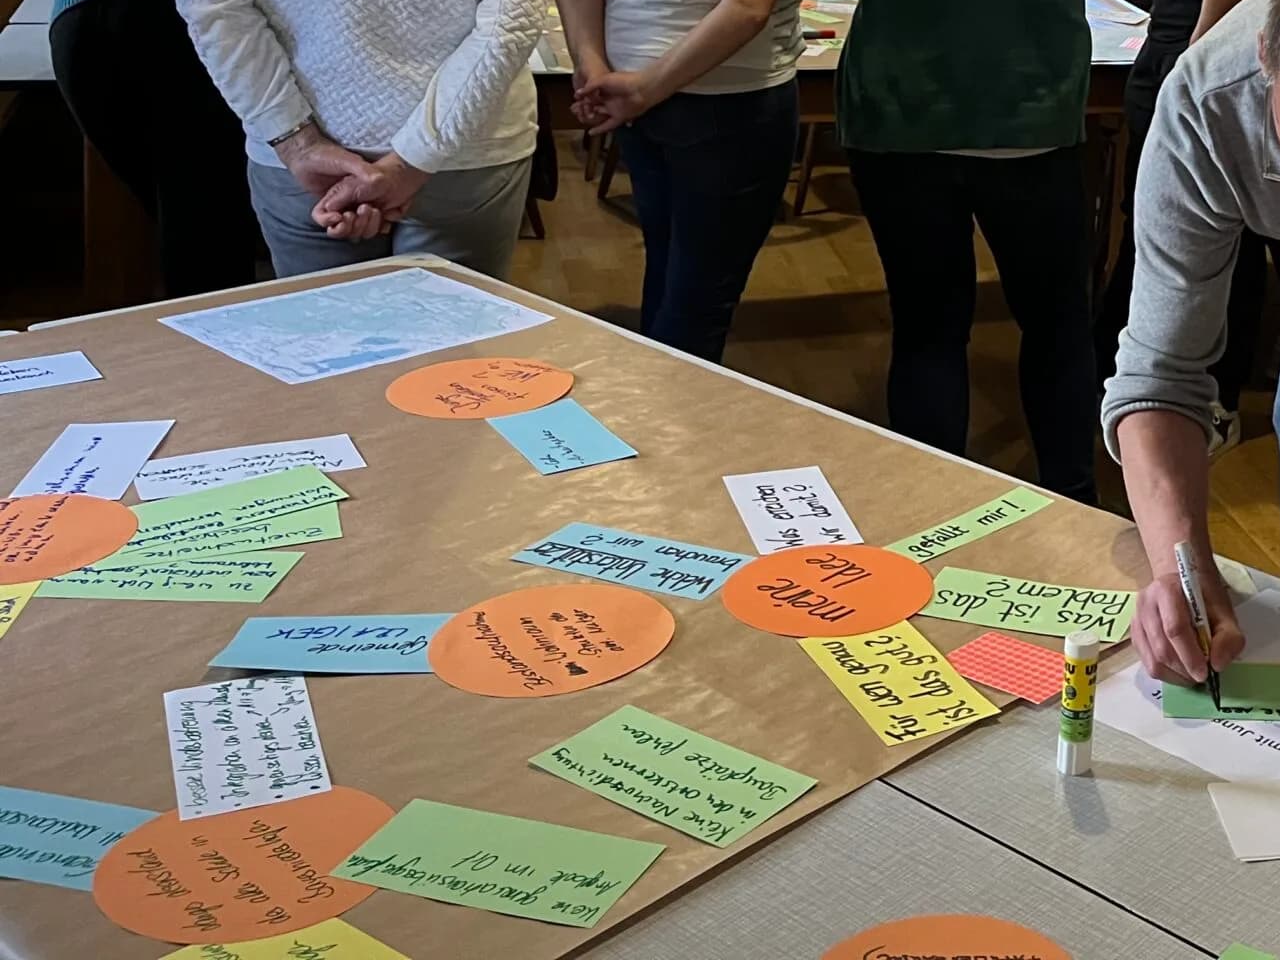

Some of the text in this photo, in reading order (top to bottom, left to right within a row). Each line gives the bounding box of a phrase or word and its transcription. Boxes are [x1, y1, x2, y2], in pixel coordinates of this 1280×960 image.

[751, 483, 806, 552] Was erreichen
[817, 526, 847, 544] wir
[907, 524, 971, 558] gefällt
[653, 544, 743, 573] brauchen
[804, 552, 873, 590] Idee
[649, 566, 716, 595] Welche
[756, 578, 857, 623] meine
[933, 589, 1116, 638] Was ist das
[306, 634, 429, 657] Gemeinde
[465, 610, 554, 691] Bestandsaufnahme
[820, 640, 928, 742] Für wen genau
[907, 669, 954, 699] das
[924, 699, 980, 726] ist
[621, 722, 788, 802] Bauplätze fehlen
[550, 746, 736, 843] Keine Nachverdichtung
[705, 792, 735, 815] den
[738, 807, 757, 826] in
[450, 849, 500, 871] Ort
[503, 861, 536, 878] im
